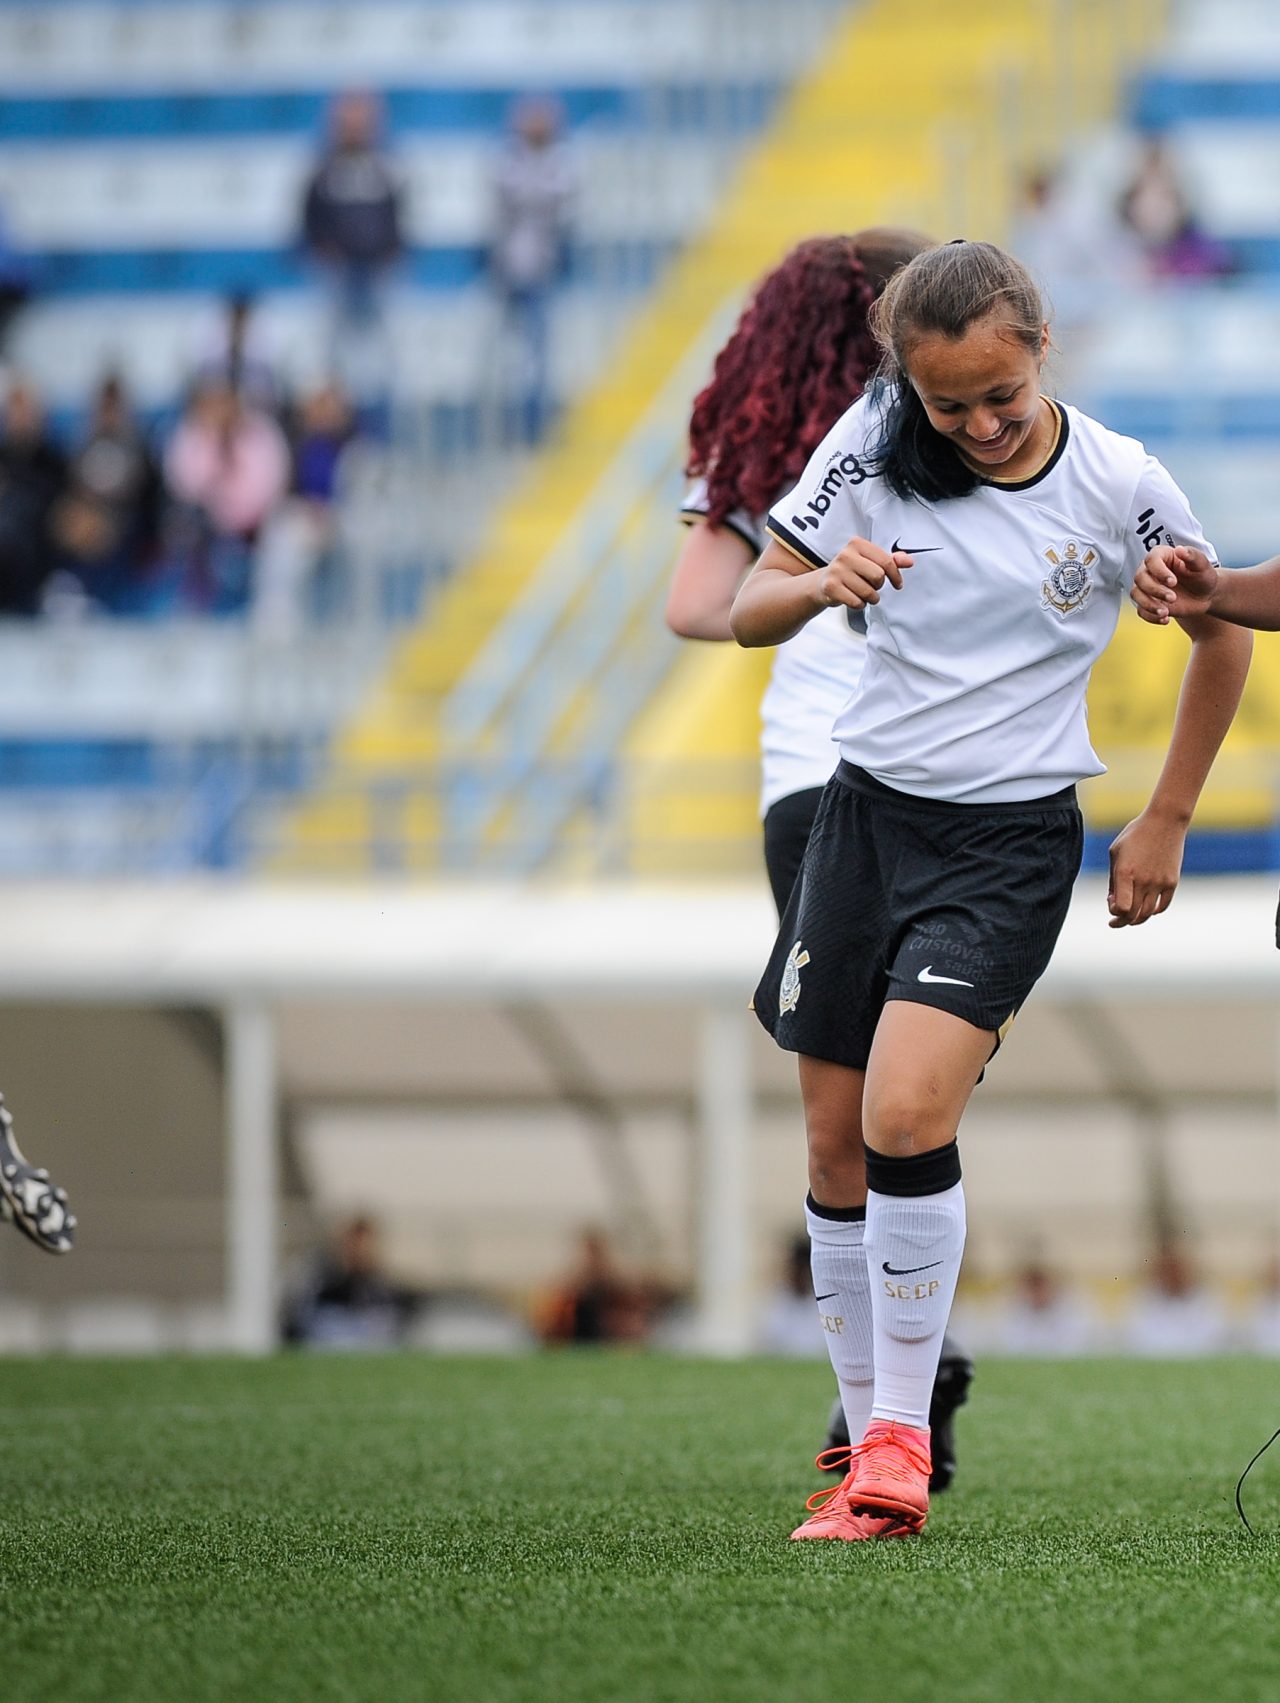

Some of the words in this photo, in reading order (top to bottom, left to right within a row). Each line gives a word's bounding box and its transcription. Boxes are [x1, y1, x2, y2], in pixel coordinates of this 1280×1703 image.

[807, 453, 867, 516] bmg
[884, 1280, 940, 1299] SCCP
[824, 1315, 844, 1335] CP
